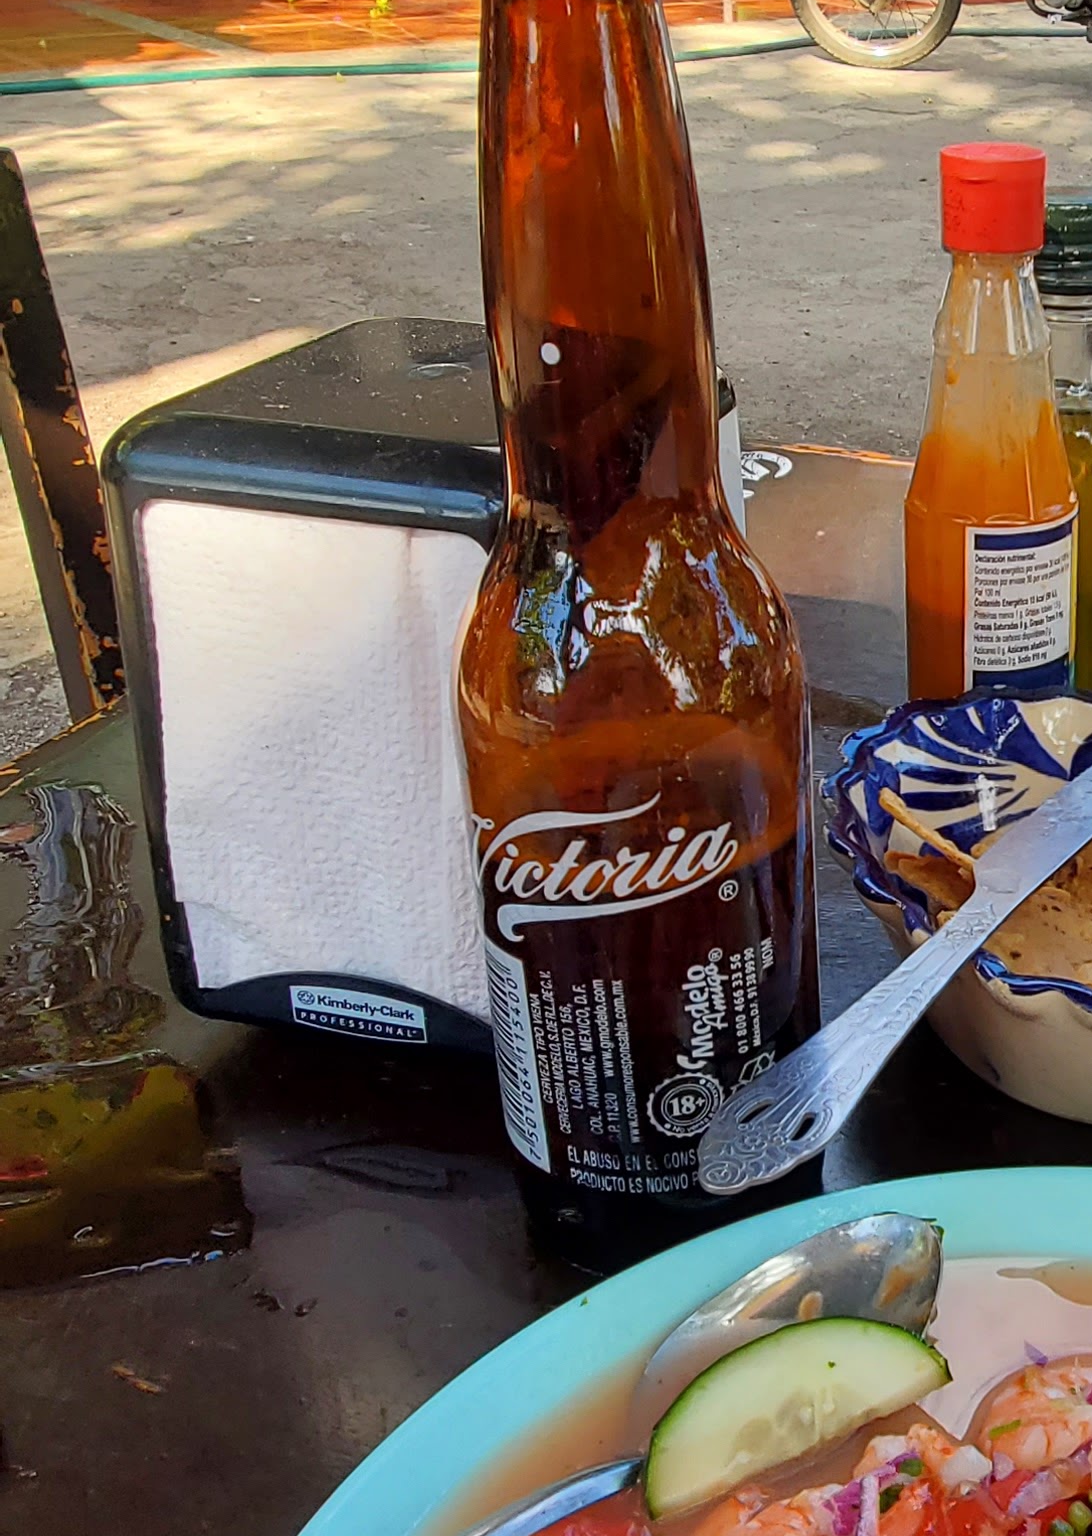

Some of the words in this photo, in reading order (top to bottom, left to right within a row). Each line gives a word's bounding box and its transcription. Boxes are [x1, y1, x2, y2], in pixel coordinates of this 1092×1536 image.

[471, 791, 738, 930] Victoria
[730, 953, 742, 970] 56
[761, 937, 774, 969] NOM
[731, 972, 744, 988] 33
[572, 983, 587, 1004] D.F.
[703, 962, 729, 1030] Amigo
[733, 989, 746, 1013] 466
[317, 995, 415, 1021] Kimberly-Clark
[529, 993, 543, 1024] VIENA
[682, 964, 714, 1058] Modelo
[300, 1011, 414, 1037] PROFESSIONAL
[592, 979, 614, 1078] www.gmodelo.com
[735, 1014, 748, 1038] 800
[533, 1026, 546, 1051] TIPO
[738, 1041, 749, 1054] 01
[561, 1027, 580, 1077] ALBERTO
[537, 1054, 553, 1104] CERVEZA
[568, 1079, 584, 1110] LAGO
[604, 1092, 620, 1122] 11320
[668, 1095, 706, 1116] 18+
[590, 1111, 604, 1135] COL.
[567, 1145, 581, 1163] EL
[583, 1149, 620, 1170] ABUSO
[625, 1154, 641, 1171] EN
[663, 1148, 699, 1168] CONS
[629, 1177, 643, 1193] ES
[646, 1173, 689, 1193] NOCIVO
